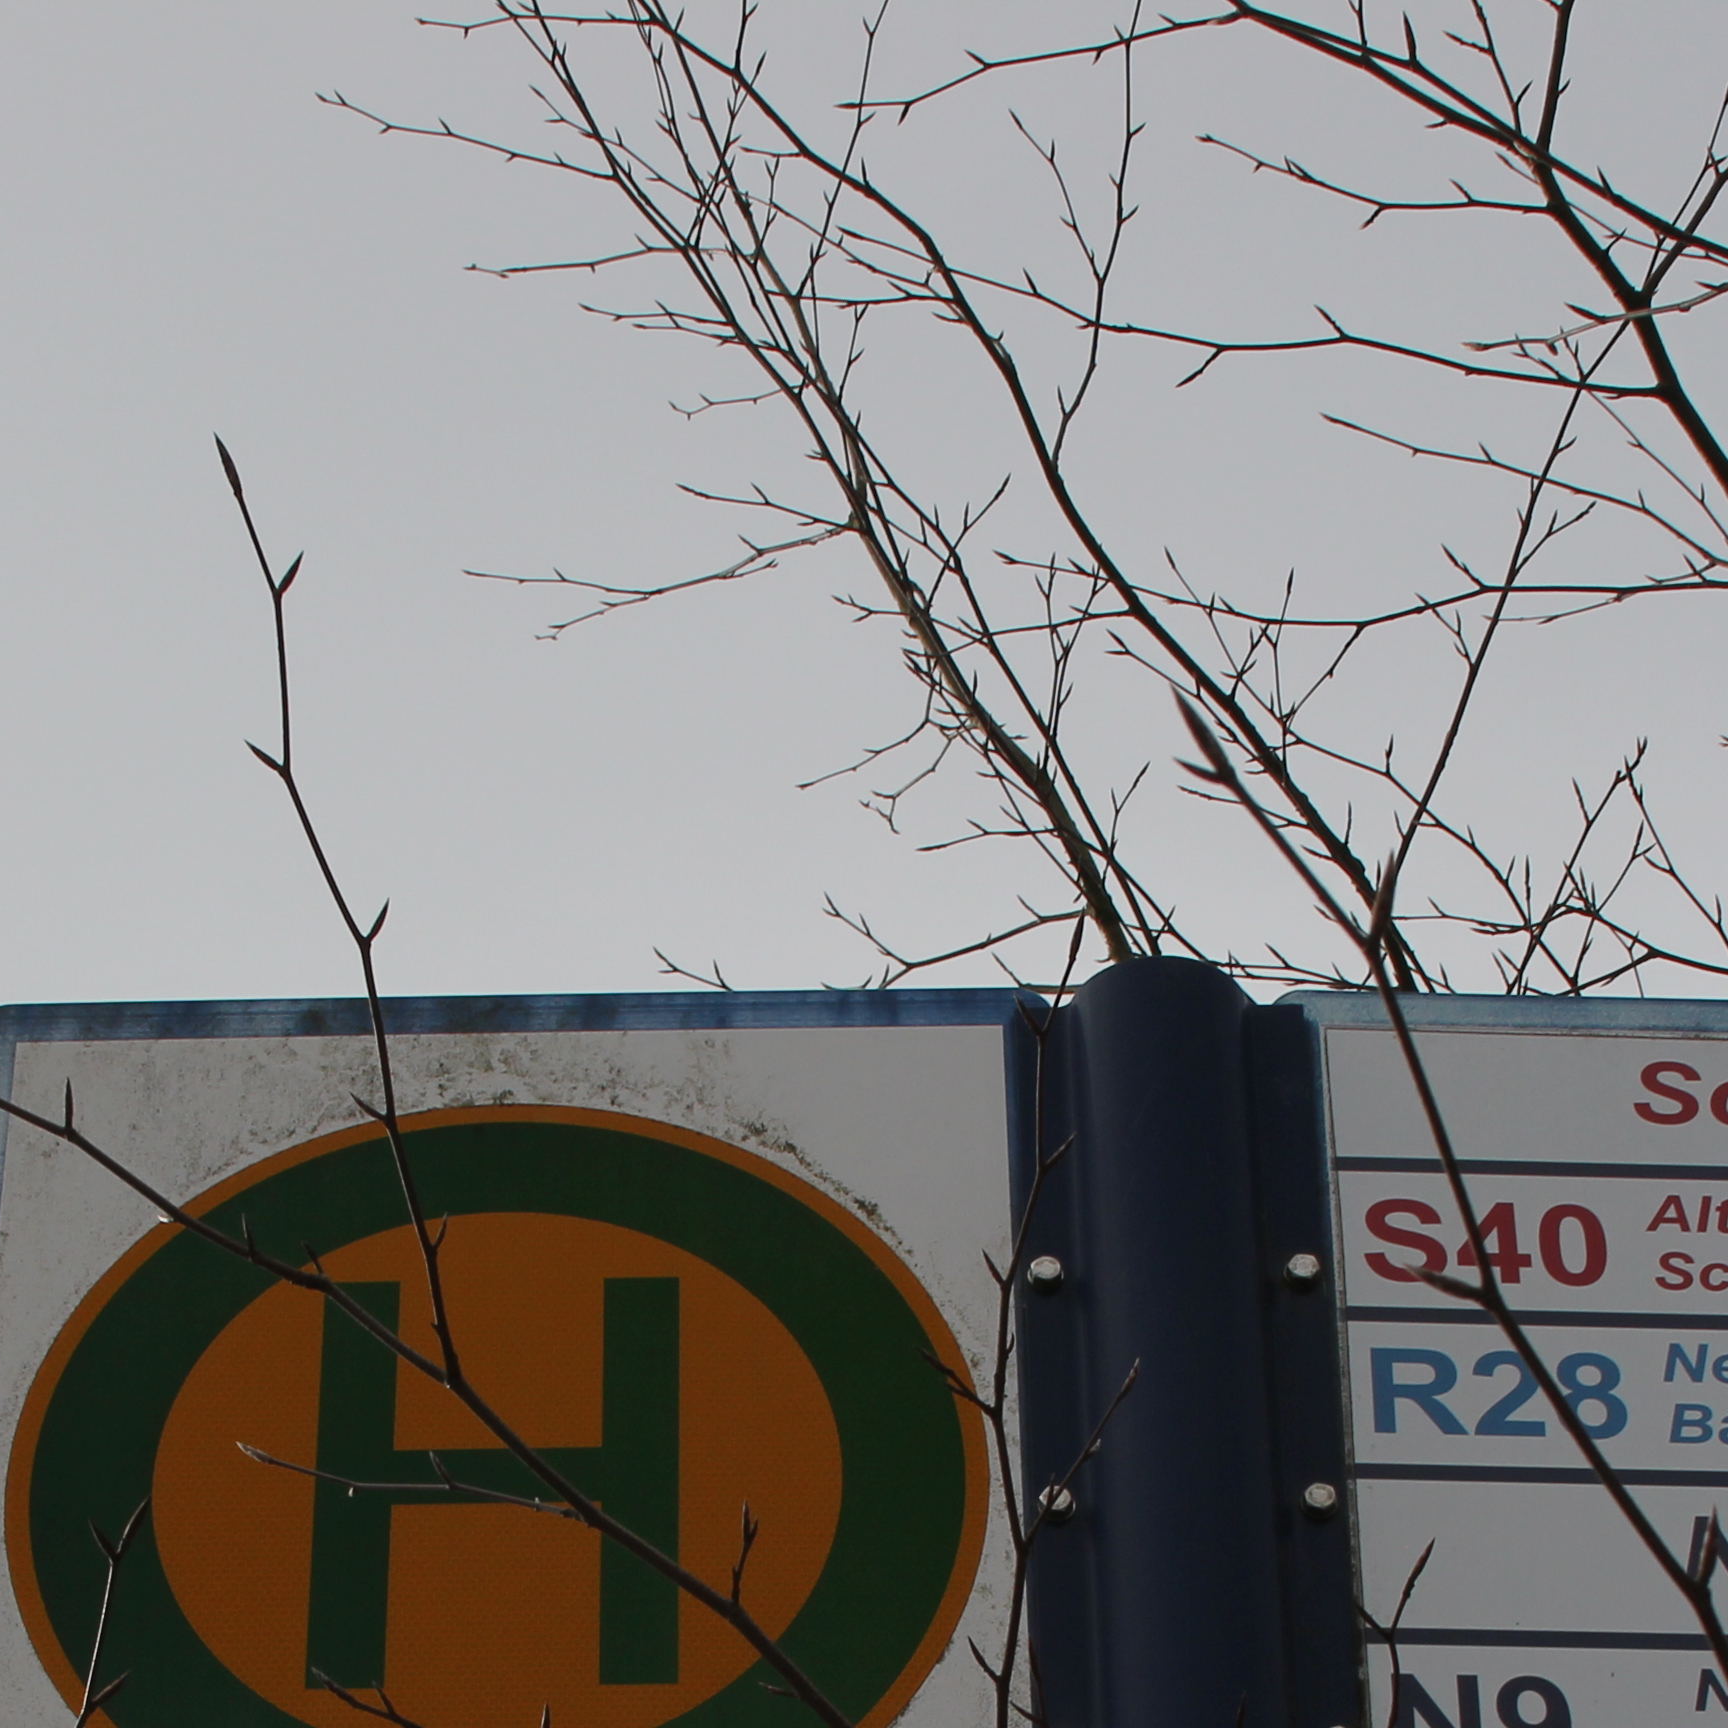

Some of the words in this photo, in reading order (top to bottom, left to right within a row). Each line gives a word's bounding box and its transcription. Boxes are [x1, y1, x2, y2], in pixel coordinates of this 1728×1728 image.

[1363, 1197, 1608, 1288] S40
[1368, 1346, 1629, 1441] R28
[304, 1276, 680, 1689] H
